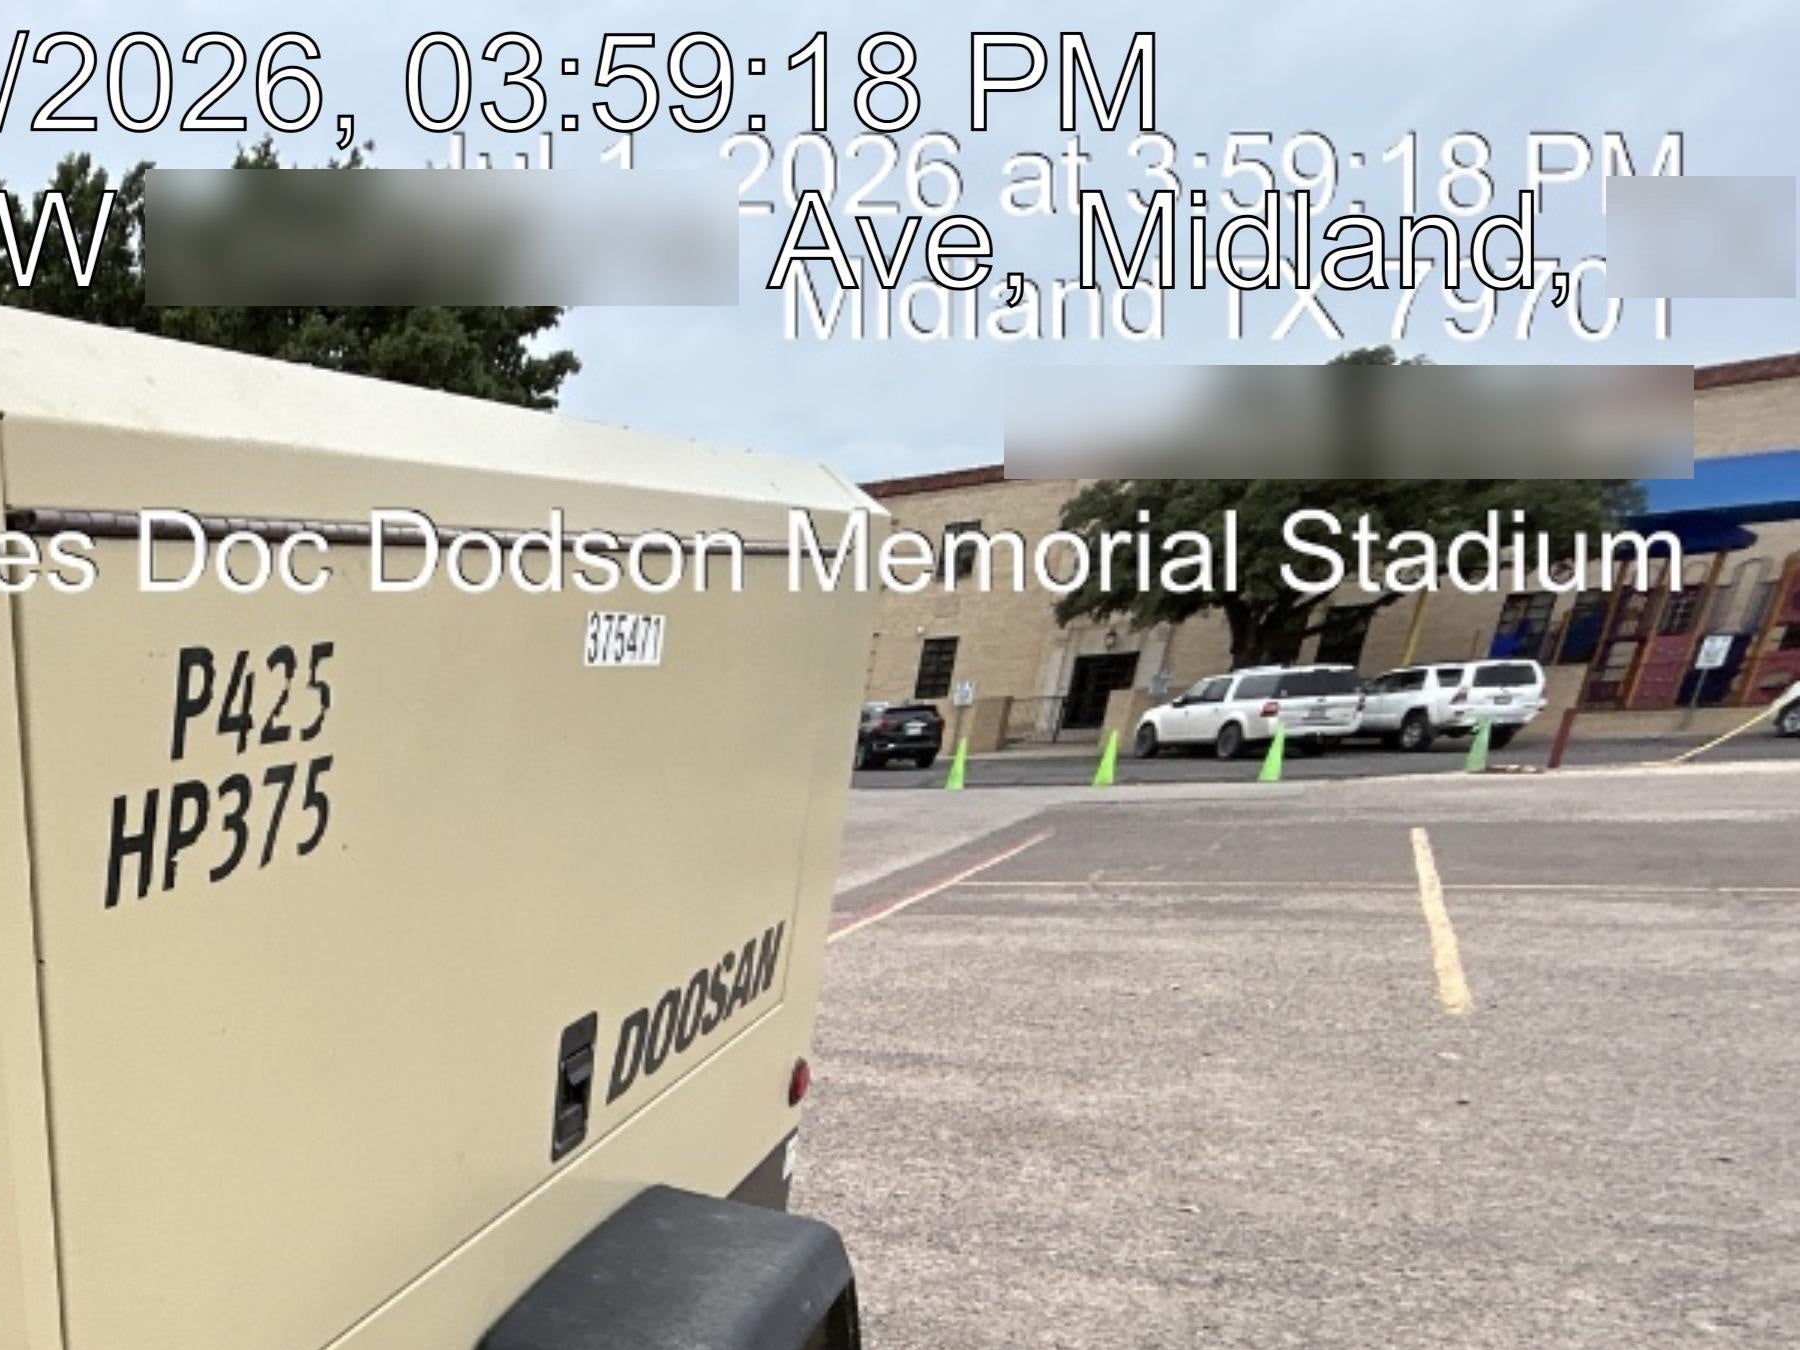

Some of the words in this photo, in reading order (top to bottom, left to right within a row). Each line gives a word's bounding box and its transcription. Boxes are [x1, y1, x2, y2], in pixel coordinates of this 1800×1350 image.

[170, 641, 335, 761] P425
[586, 612, 663, 664] 375471
[104, 754, 334, 910] HP375
[606, 919, 786, 1106] DOOSAN
